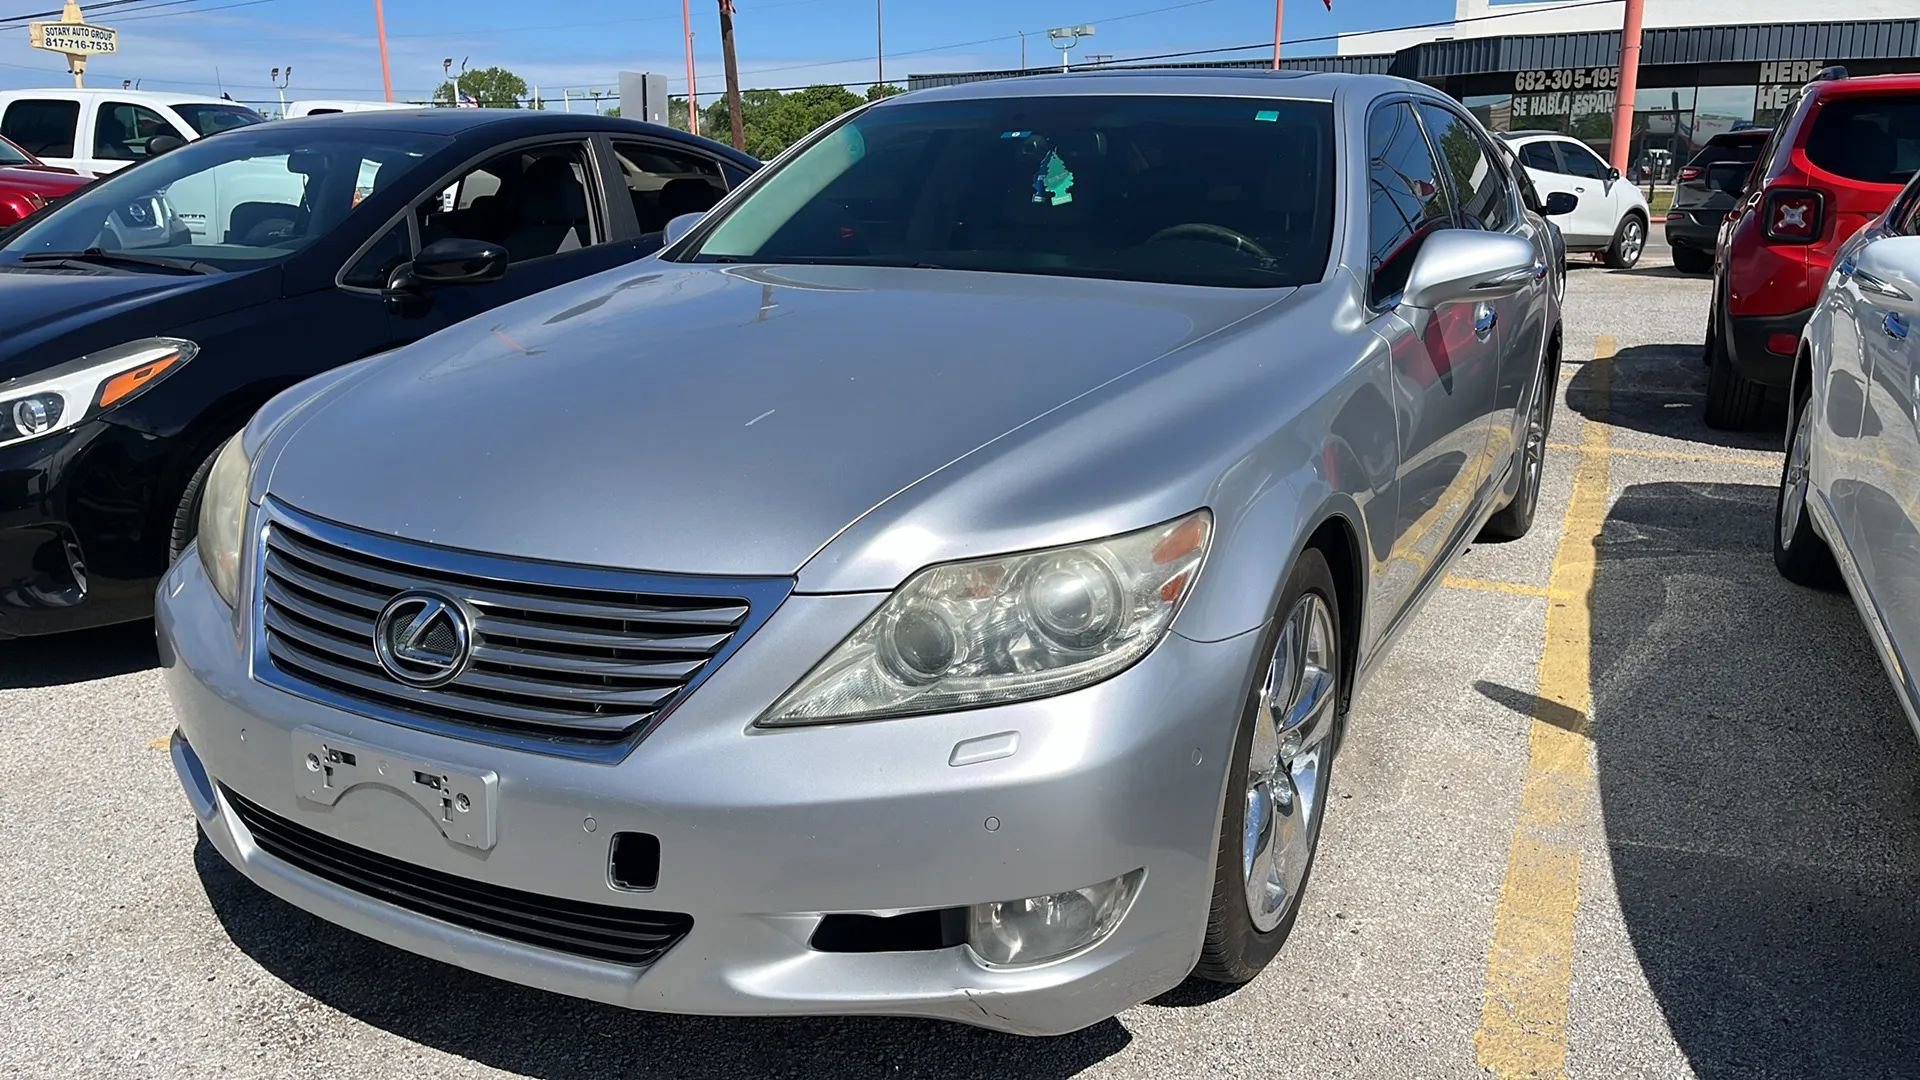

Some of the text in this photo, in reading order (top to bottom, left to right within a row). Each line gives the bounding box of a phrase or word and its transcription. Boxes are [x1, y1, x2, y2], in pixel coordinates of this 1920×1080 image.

[45, 27, 113, 41] SOTARY AUTO GROUP
[45, 37, 115, 51] 817-716-7533
[1515, 67, 1620, 91] 682-305-195
[1512, 93, 1617, 116] SE HABLA ESPAN
